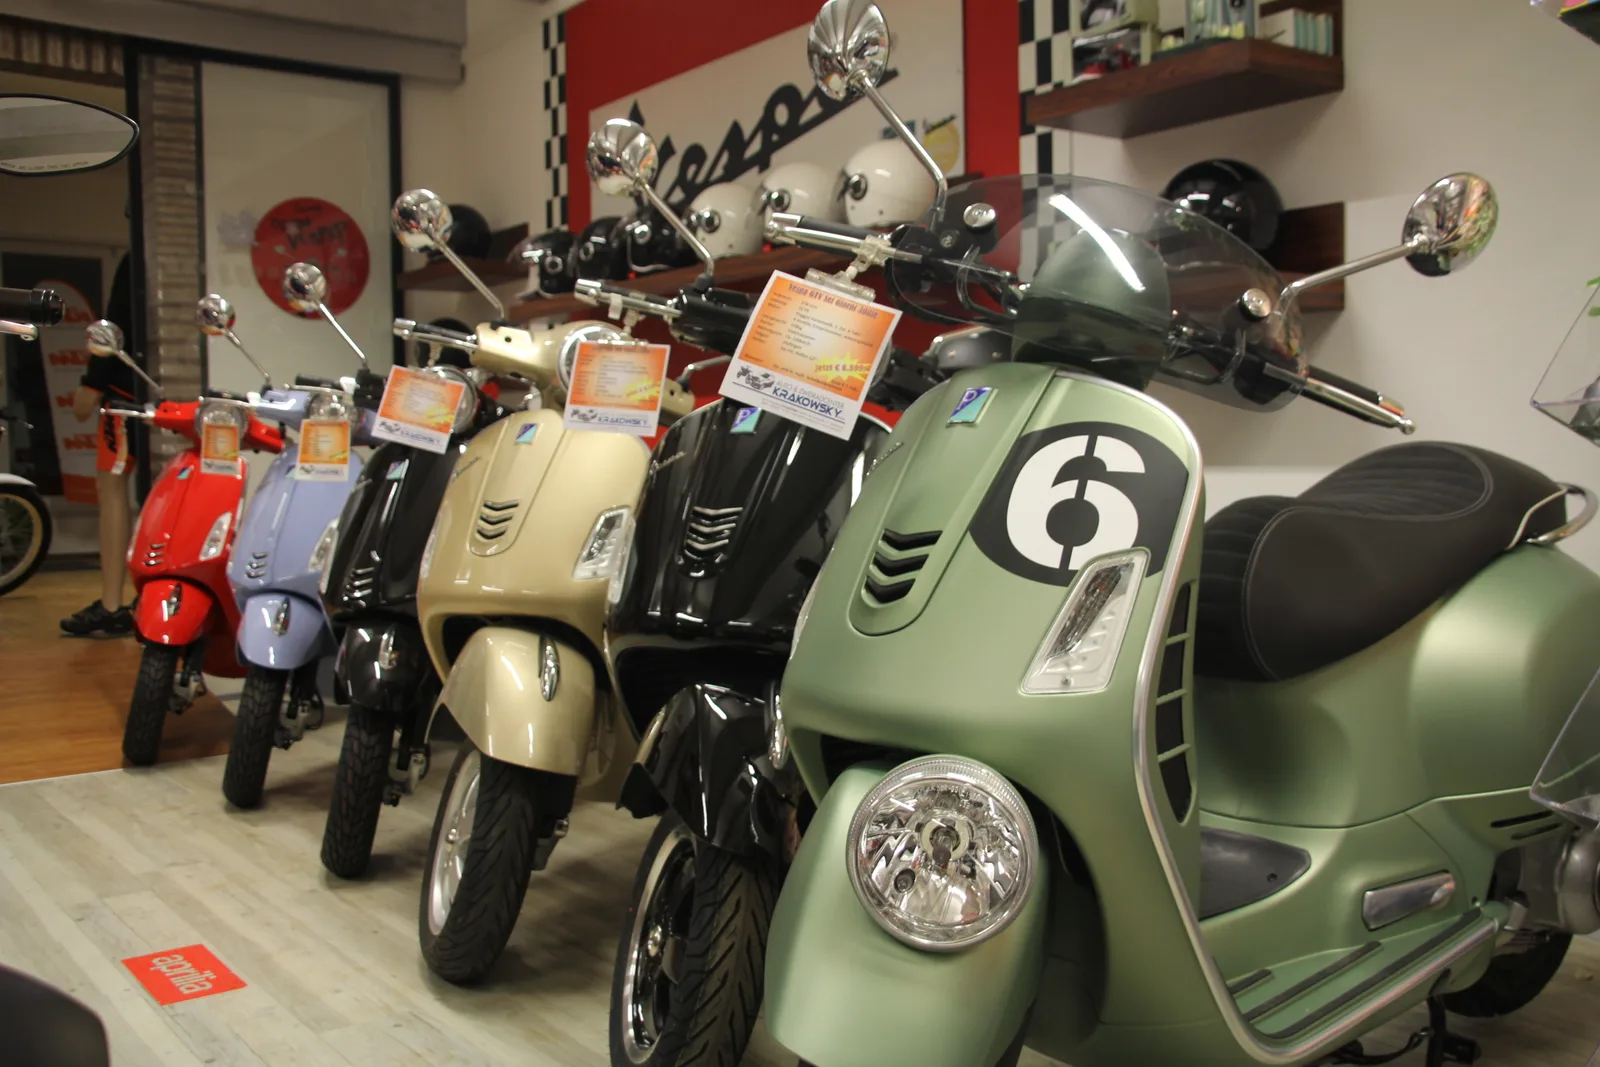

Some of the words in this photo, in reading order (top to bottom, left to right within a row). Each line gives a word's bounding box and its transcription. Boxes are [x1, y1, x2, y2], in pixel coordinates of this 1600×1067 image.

[788, 282, 809, 296] Vespa
[772, 386, 843, 418] KRAKOWSKY
[1006, 434, 1147, 571] 6
[150, 954, 217, 995] aprilia
